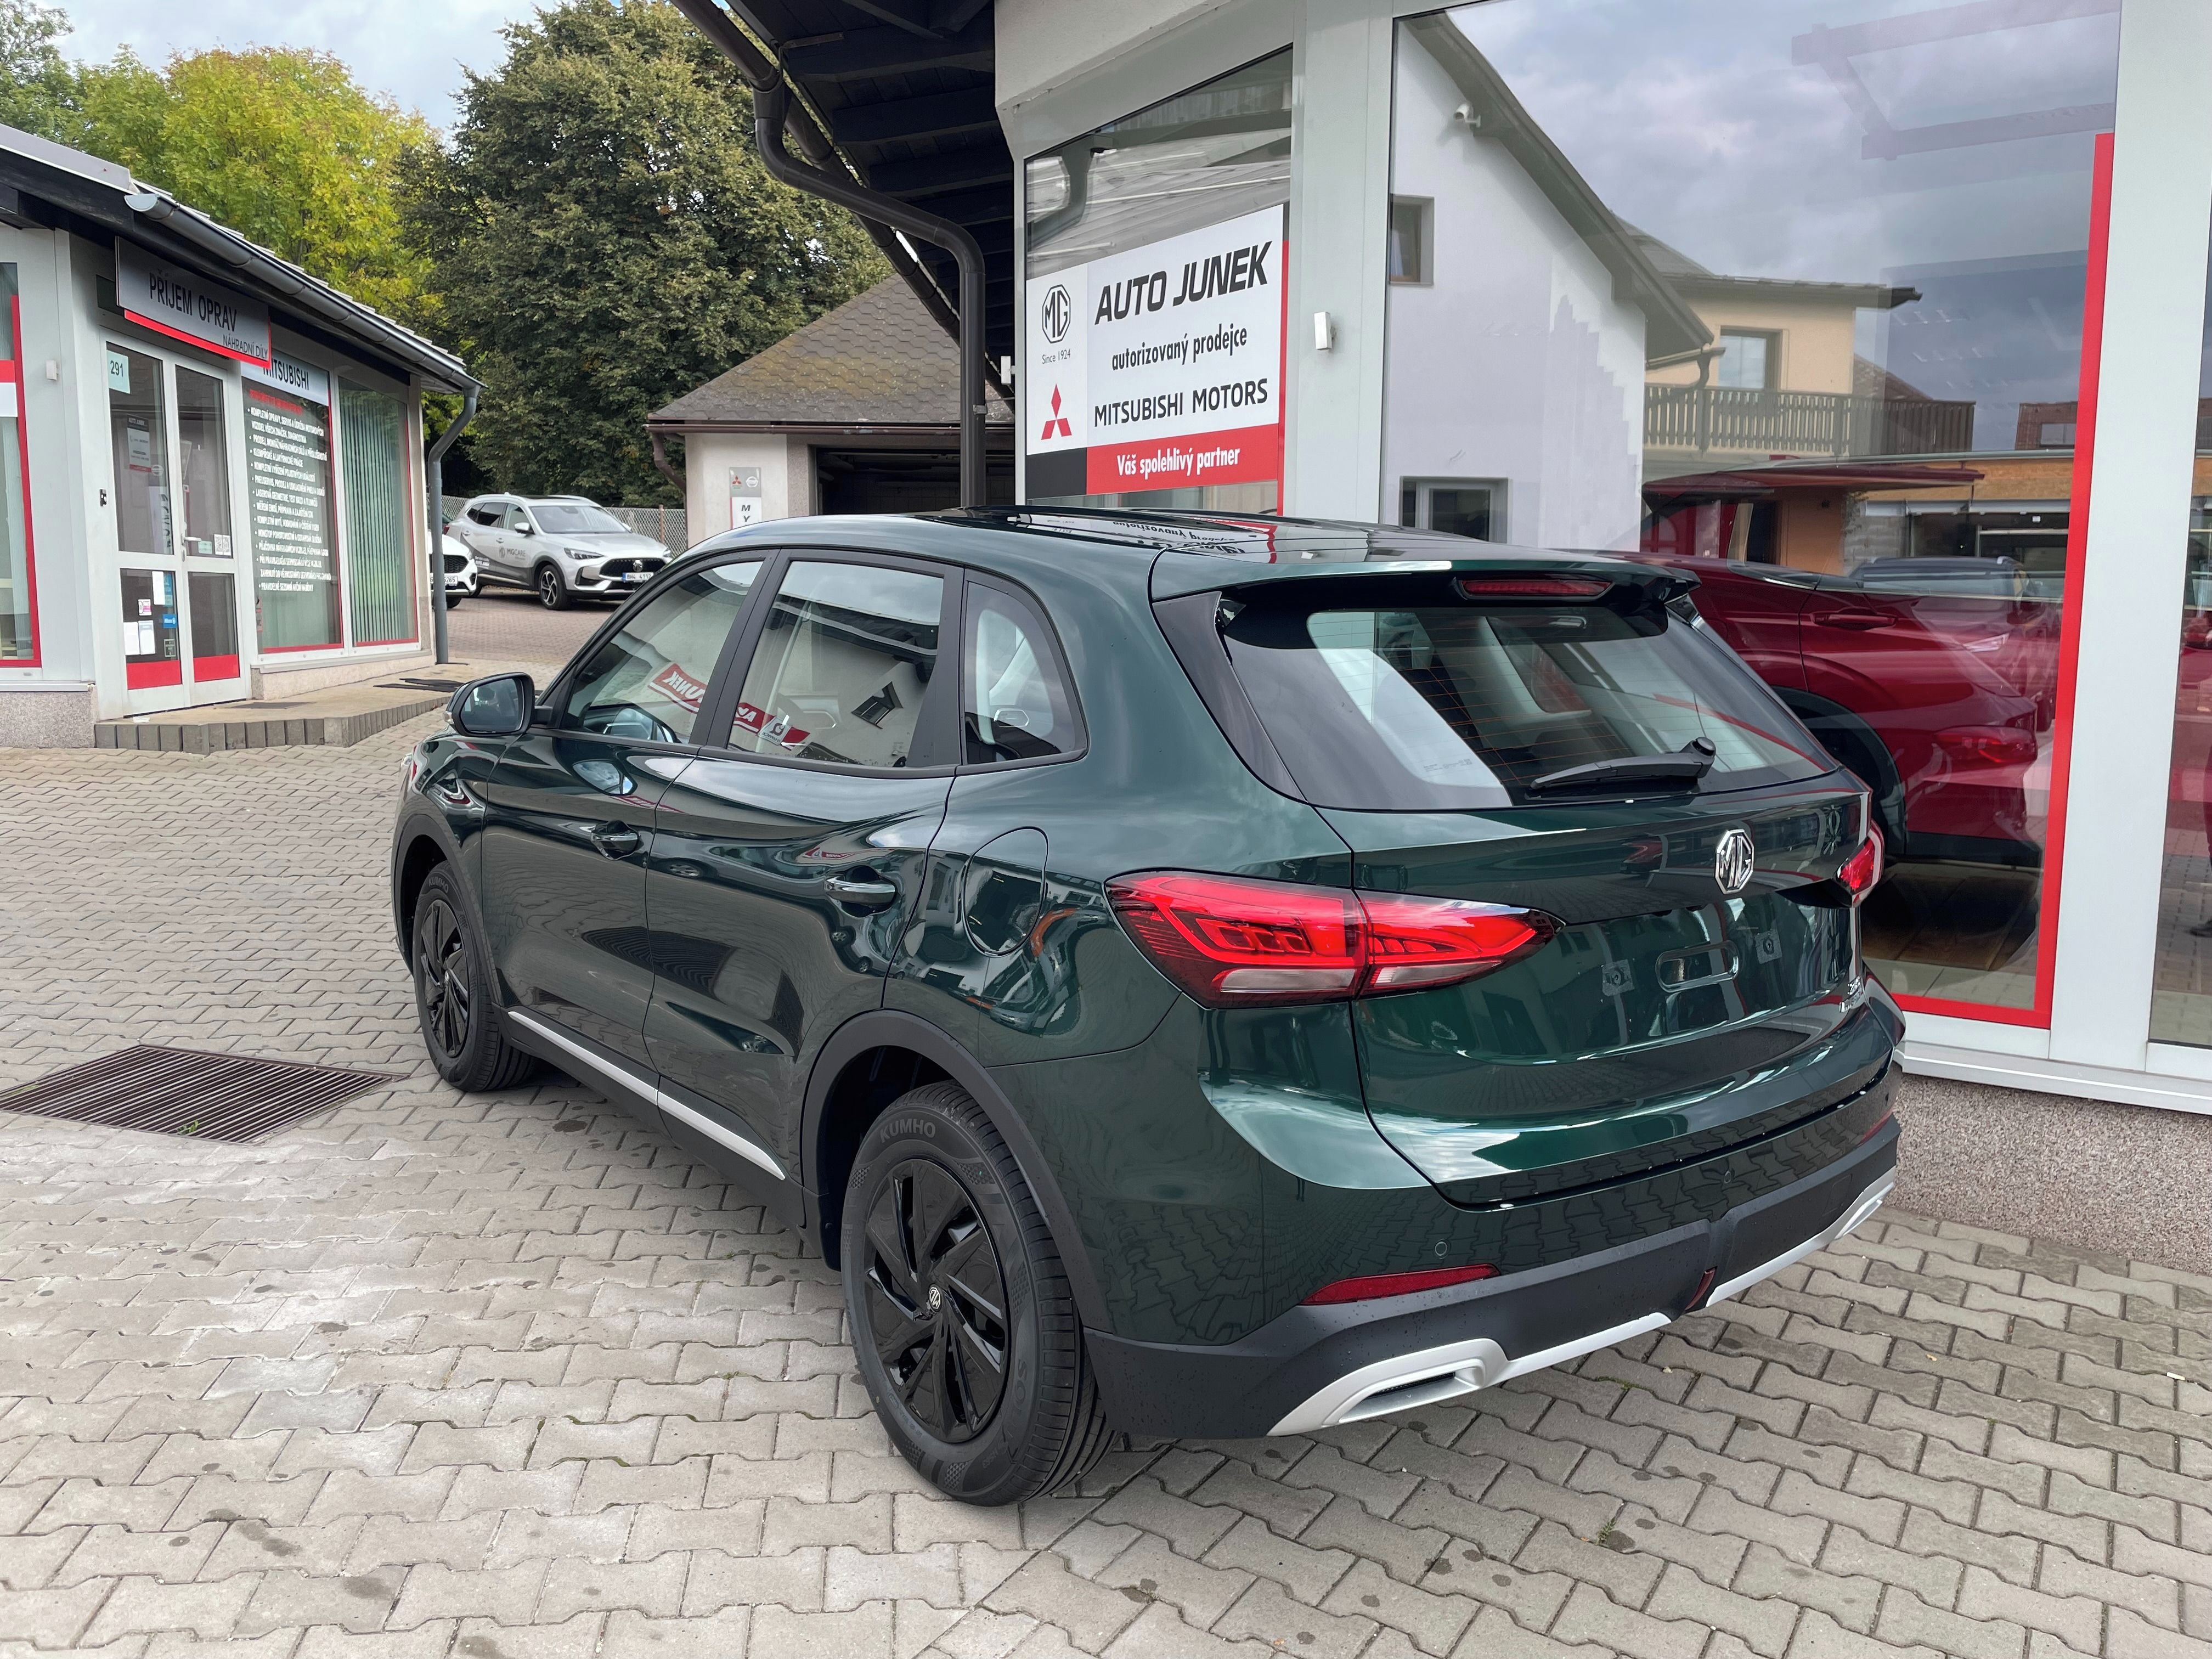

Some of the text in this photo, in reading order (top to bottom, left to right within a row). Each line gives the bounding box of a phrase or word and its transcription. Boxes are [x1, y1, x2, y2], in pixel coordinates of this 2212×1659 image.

[149, 269, 237, 331] PŘÍJEM OPRAV
[1094, 241, 1272, 325] AUTO JUNEK
[1042, 284, 1070, 343] MG
[223, 334, 268, 360] NÁHRADNÍ DÍLY
[1042, 349, 1071, 364] Since 1924
[1112, 324, 1247, 370] autorizovaný prodejce
[110, 360, 123, 377] 291
[1094, 378, 1267, 427] MITSUBISHI MOTORS
[1117, 447, 1240, 480] Váš spolehlivý partner
[1715, 829, 1755, 895] MG
[428, 877, 449, 894] KUMHO
[880, 1119, 936, 1143] KUMHO
